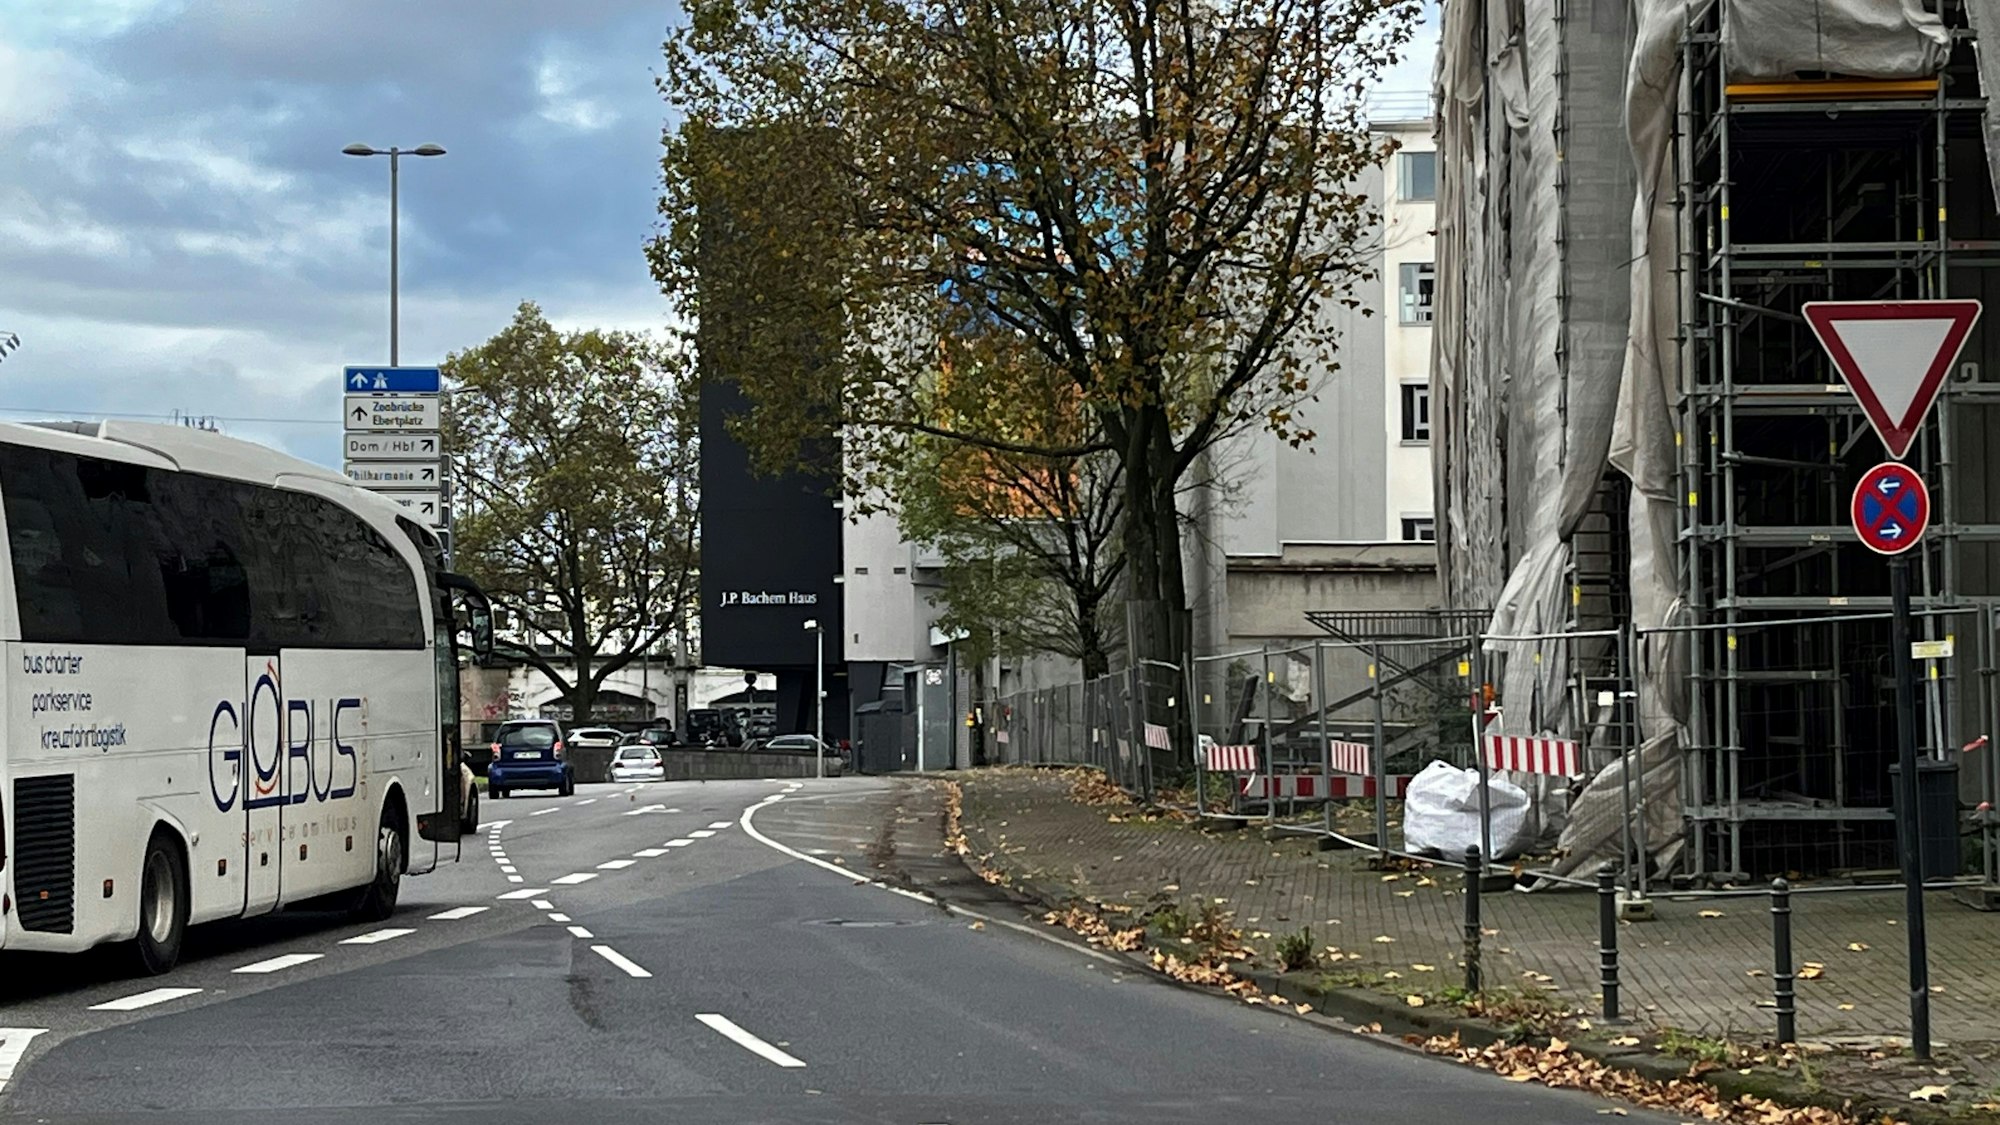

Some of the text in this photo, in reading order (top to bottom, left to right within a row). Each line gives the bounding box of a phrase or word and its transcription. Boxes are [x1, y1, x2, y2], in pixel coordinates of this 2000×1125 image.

[373, 401, 424, 412] Zoobrücke
[373, 415, 423, 428] Ebertplatz
[350, 441, 379, 452] Dom
[393, 441, 416, 452] Hbf
[348, 469, 414, 481] Philharmonie
[742, 591, 786, 605] Bachem
[789, 591, 817, 604] Haus
[23, 648, 82, 674] bus charter
[32, 687, 92, 719] parkservice
[41, 722, 127, 753] kreuzfahrtlogistik
[209, 672, 361, 813] GLOBUS
